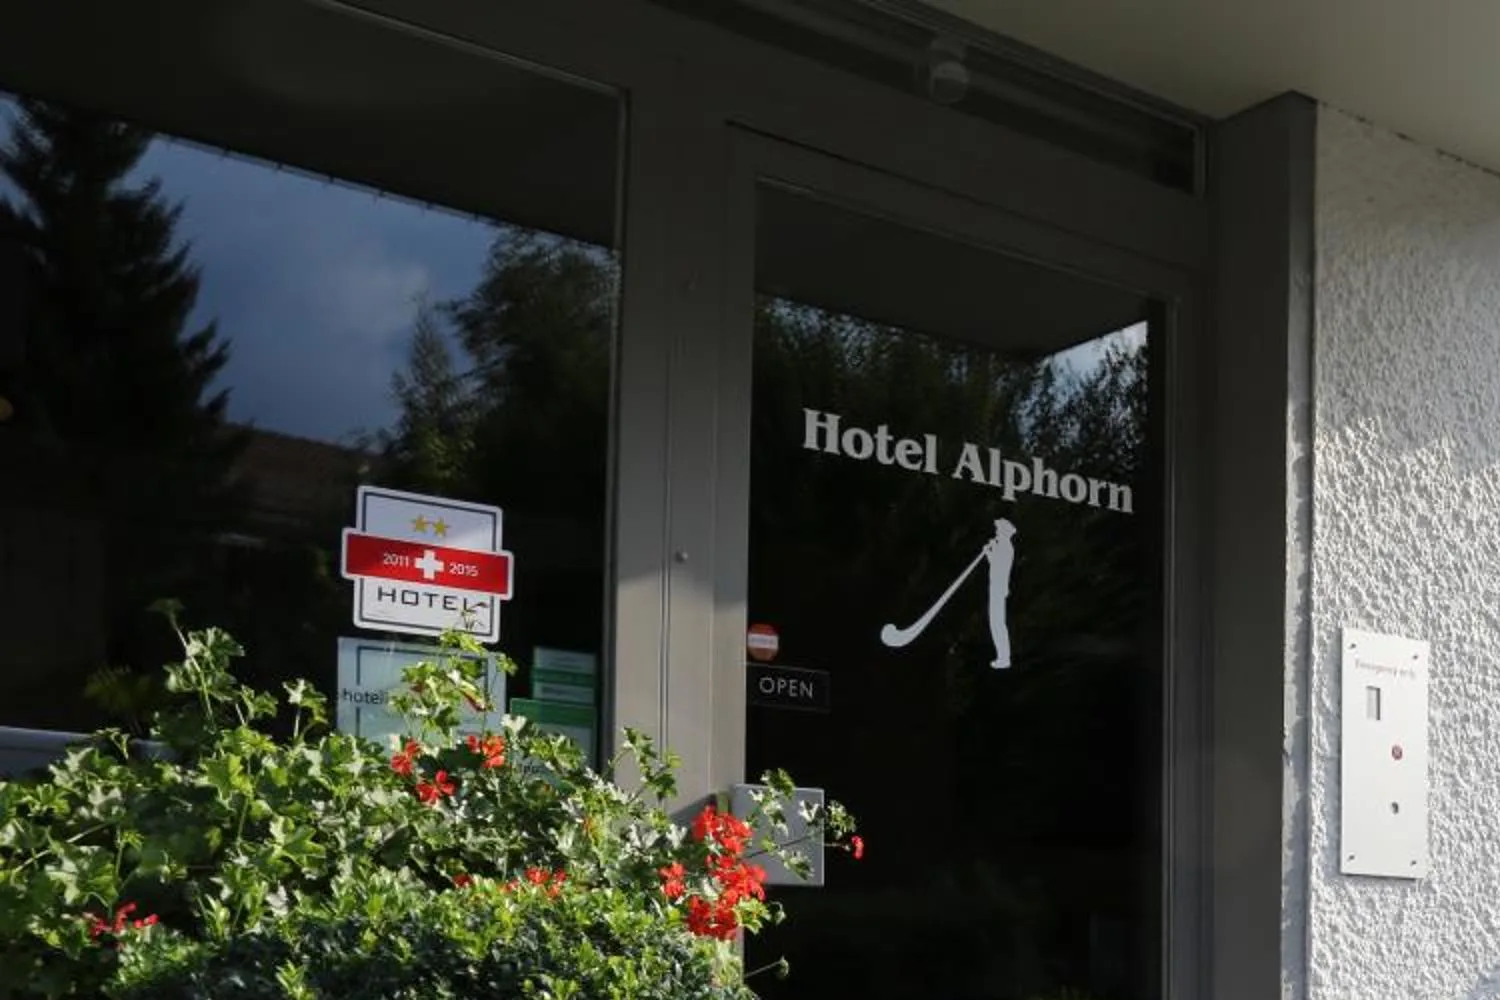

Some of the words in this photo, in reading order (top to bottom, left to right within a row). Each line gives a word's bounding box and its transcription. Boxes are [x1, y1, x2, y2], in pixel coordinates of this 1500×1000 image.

[802, 407, 939, 475] Hotel
[952, 442, 1133, 513] Alphorn
[383, 552, 409, 567] 2011
[377, 586, 476, 614] HOTEL
[759, 677, 813, 699] OPEN
